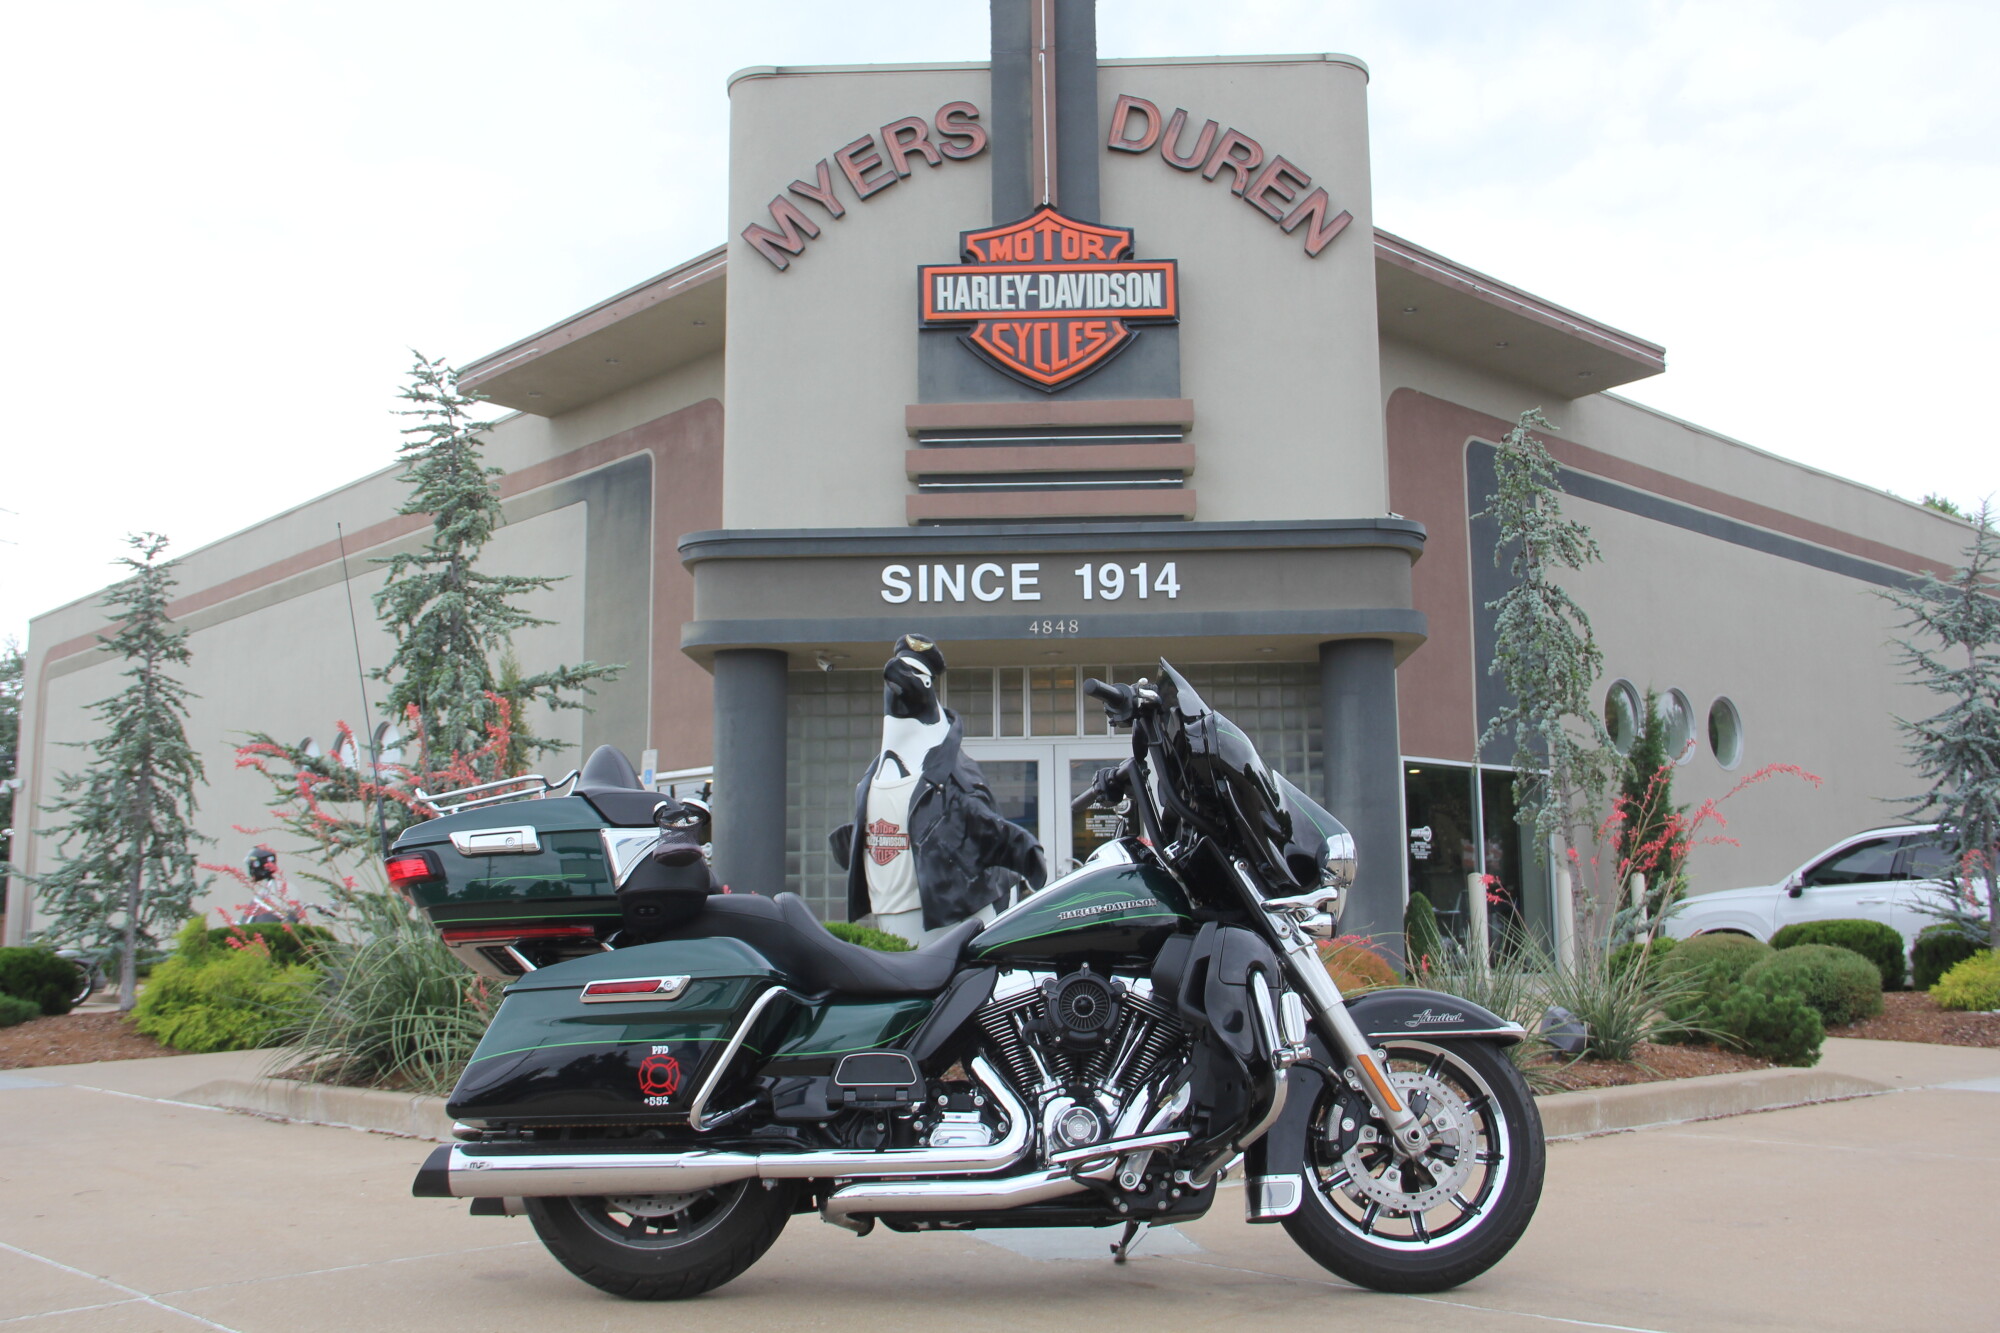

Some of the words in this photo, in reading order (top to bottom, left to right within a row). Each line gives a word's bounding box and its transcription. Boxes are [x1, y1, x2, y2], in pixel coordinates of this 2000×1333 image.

[741, 101, 987, 271] MYERS
[1107, 94, 1354, 258] DUREN
[989, 219, 1106, 262] MOTOR
[936, 272, 1162, 311] HARLEY-DAVIDSON
[992, 320, 1108, 373] CYCLES
[881, 563, 1041, 603] SINCE
[1075, 562, 1180, 600] 1914
[1029, 619, 1079, 634] 4848
[1404, 1008, 1465, 1028] Limited
[651, 1045, 669, 1055] PFD
